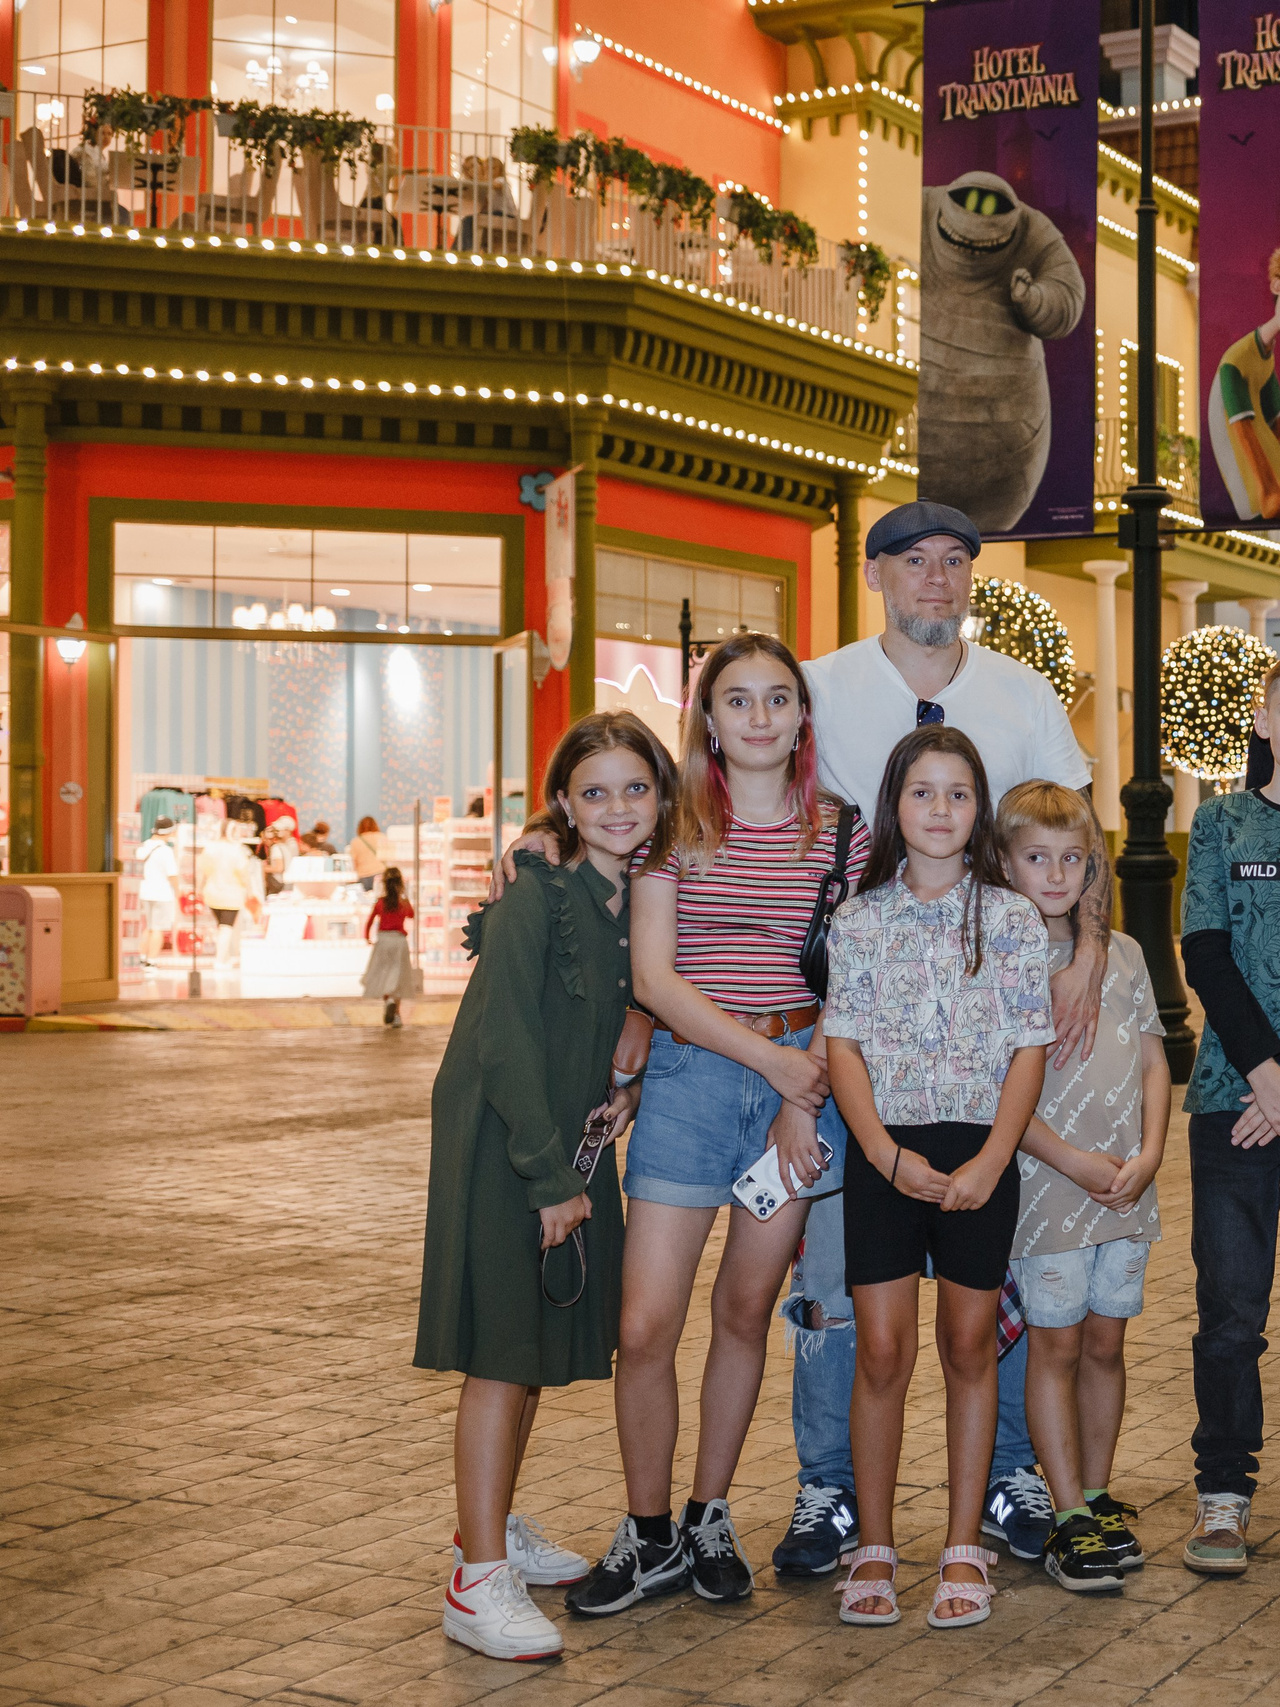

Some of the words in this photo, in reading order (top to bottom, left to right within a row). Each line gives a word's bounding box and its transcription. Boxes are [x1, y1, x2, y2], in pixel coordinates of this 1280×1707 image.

[973, 44, 1046, 83] HOTEL
[938, 72, 1079, 121] TRANSYLVANIA
[1240, 864, 1277, 877] WILD
